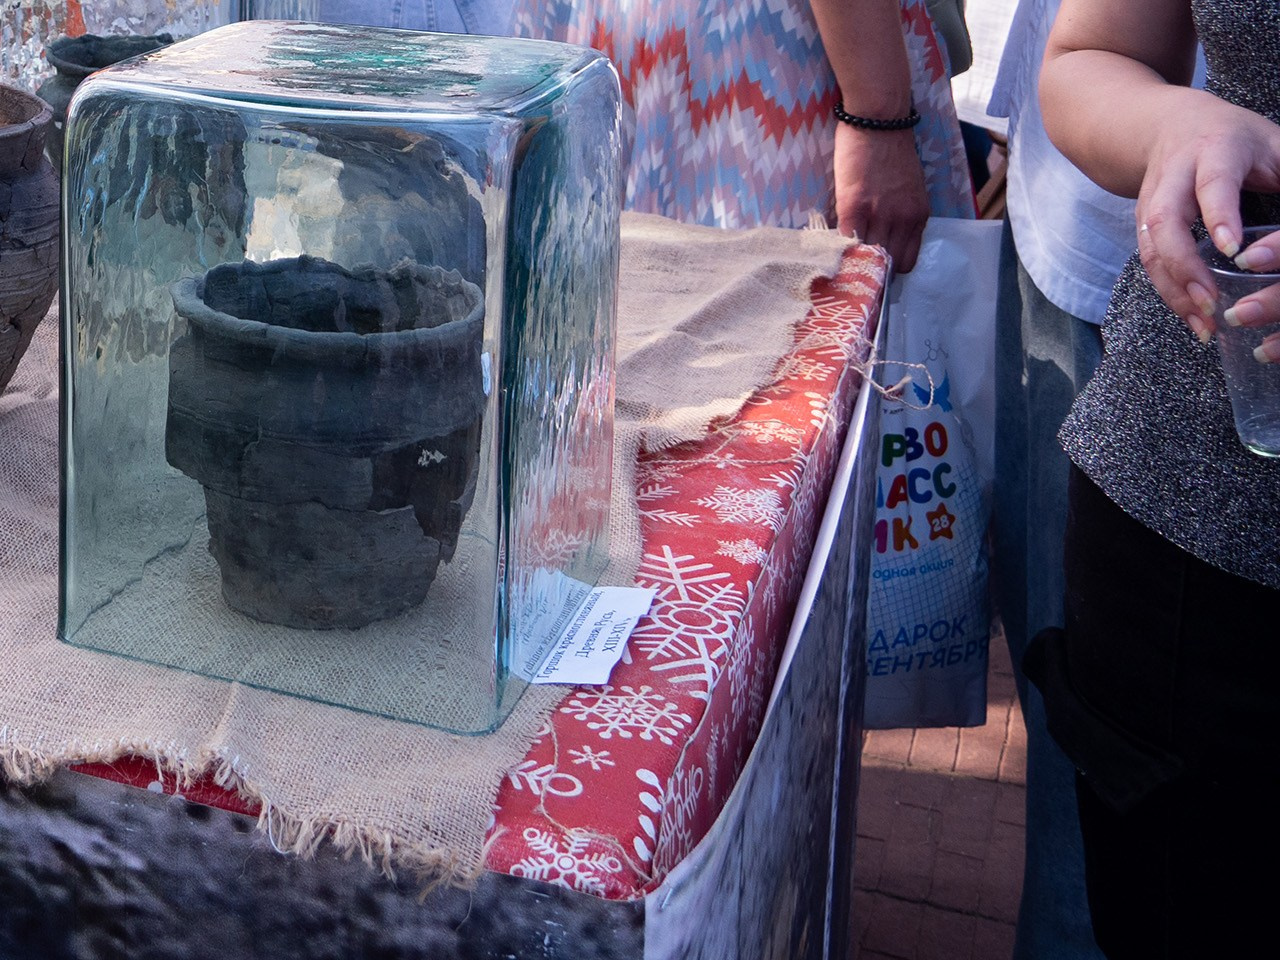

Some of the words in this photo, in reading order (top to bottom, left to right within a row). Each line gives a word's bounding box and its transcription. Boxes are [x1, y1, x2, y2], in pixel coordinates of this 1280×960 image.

[881, 421, 948, 467] РВО
[932, 515, 950, 532] 28
[872, 567, 916, 581] одная
[919, 558, 954, 576] акция
[594, 609, 617, 631] Русь,
[868, 614, 968, 654] ДАРОК
[536, 646, 565, 679] Горшок
